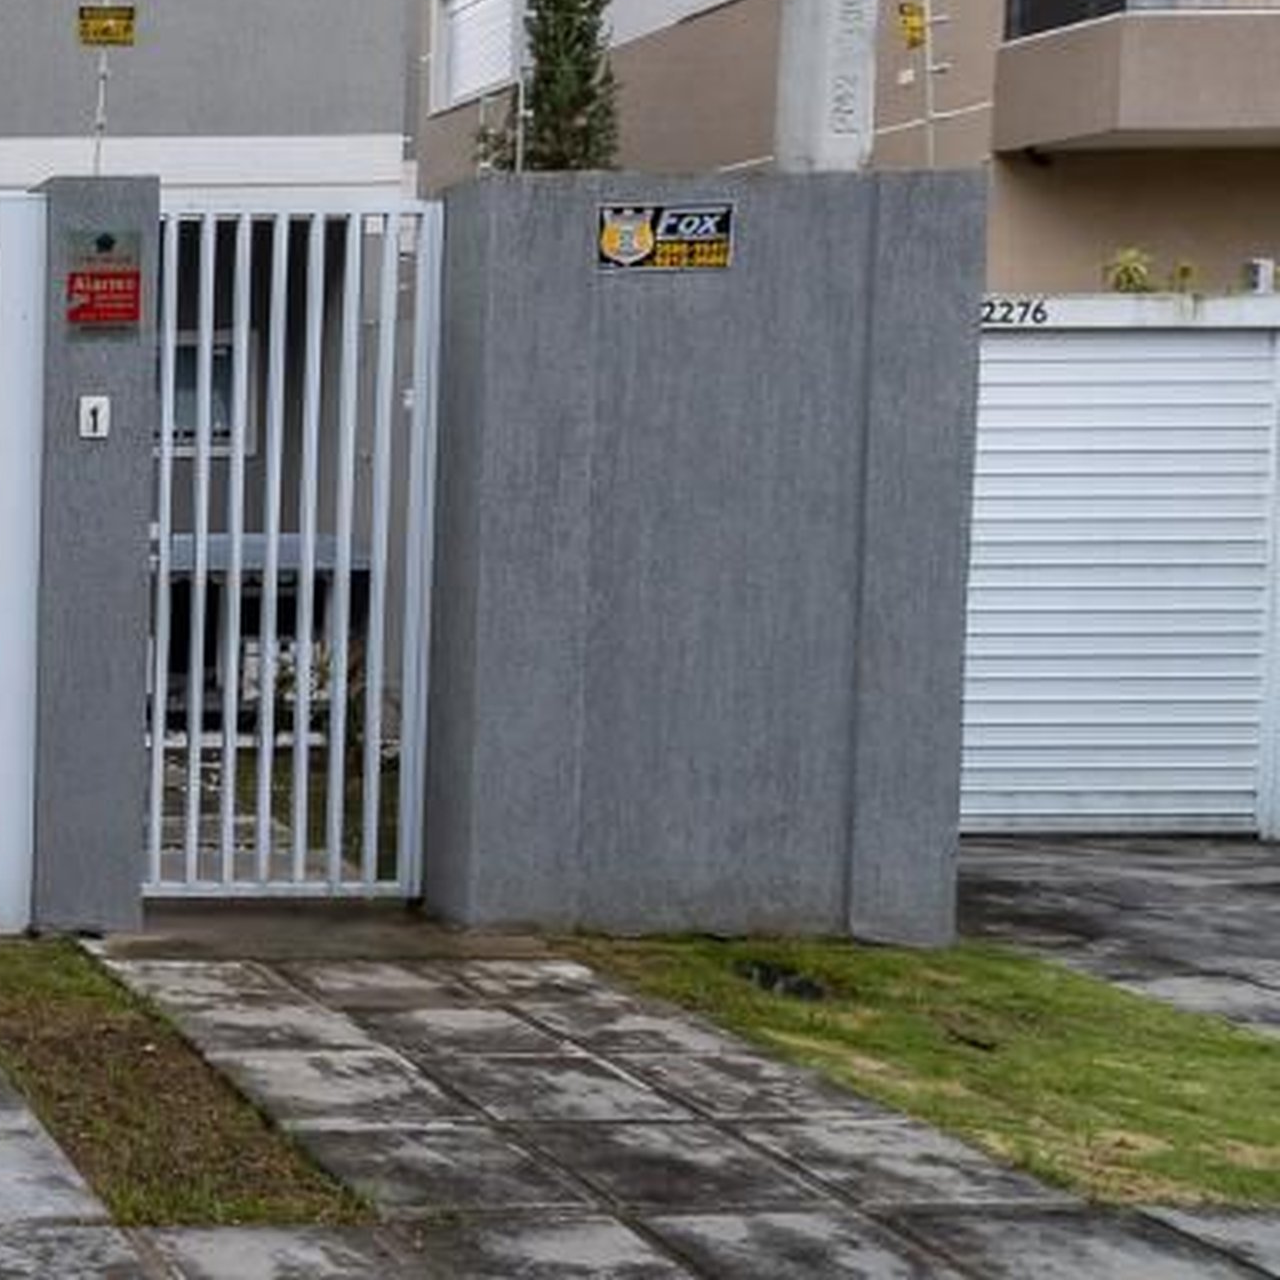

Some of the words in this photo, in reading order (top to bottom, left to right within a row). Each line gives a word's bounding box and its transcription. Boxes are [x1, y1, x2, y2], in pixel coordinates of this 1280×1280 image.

[657, 209, 723, 235] FOX
[980, 301, 1048, 324] 2276
[89, 407, 99, 433] 1
